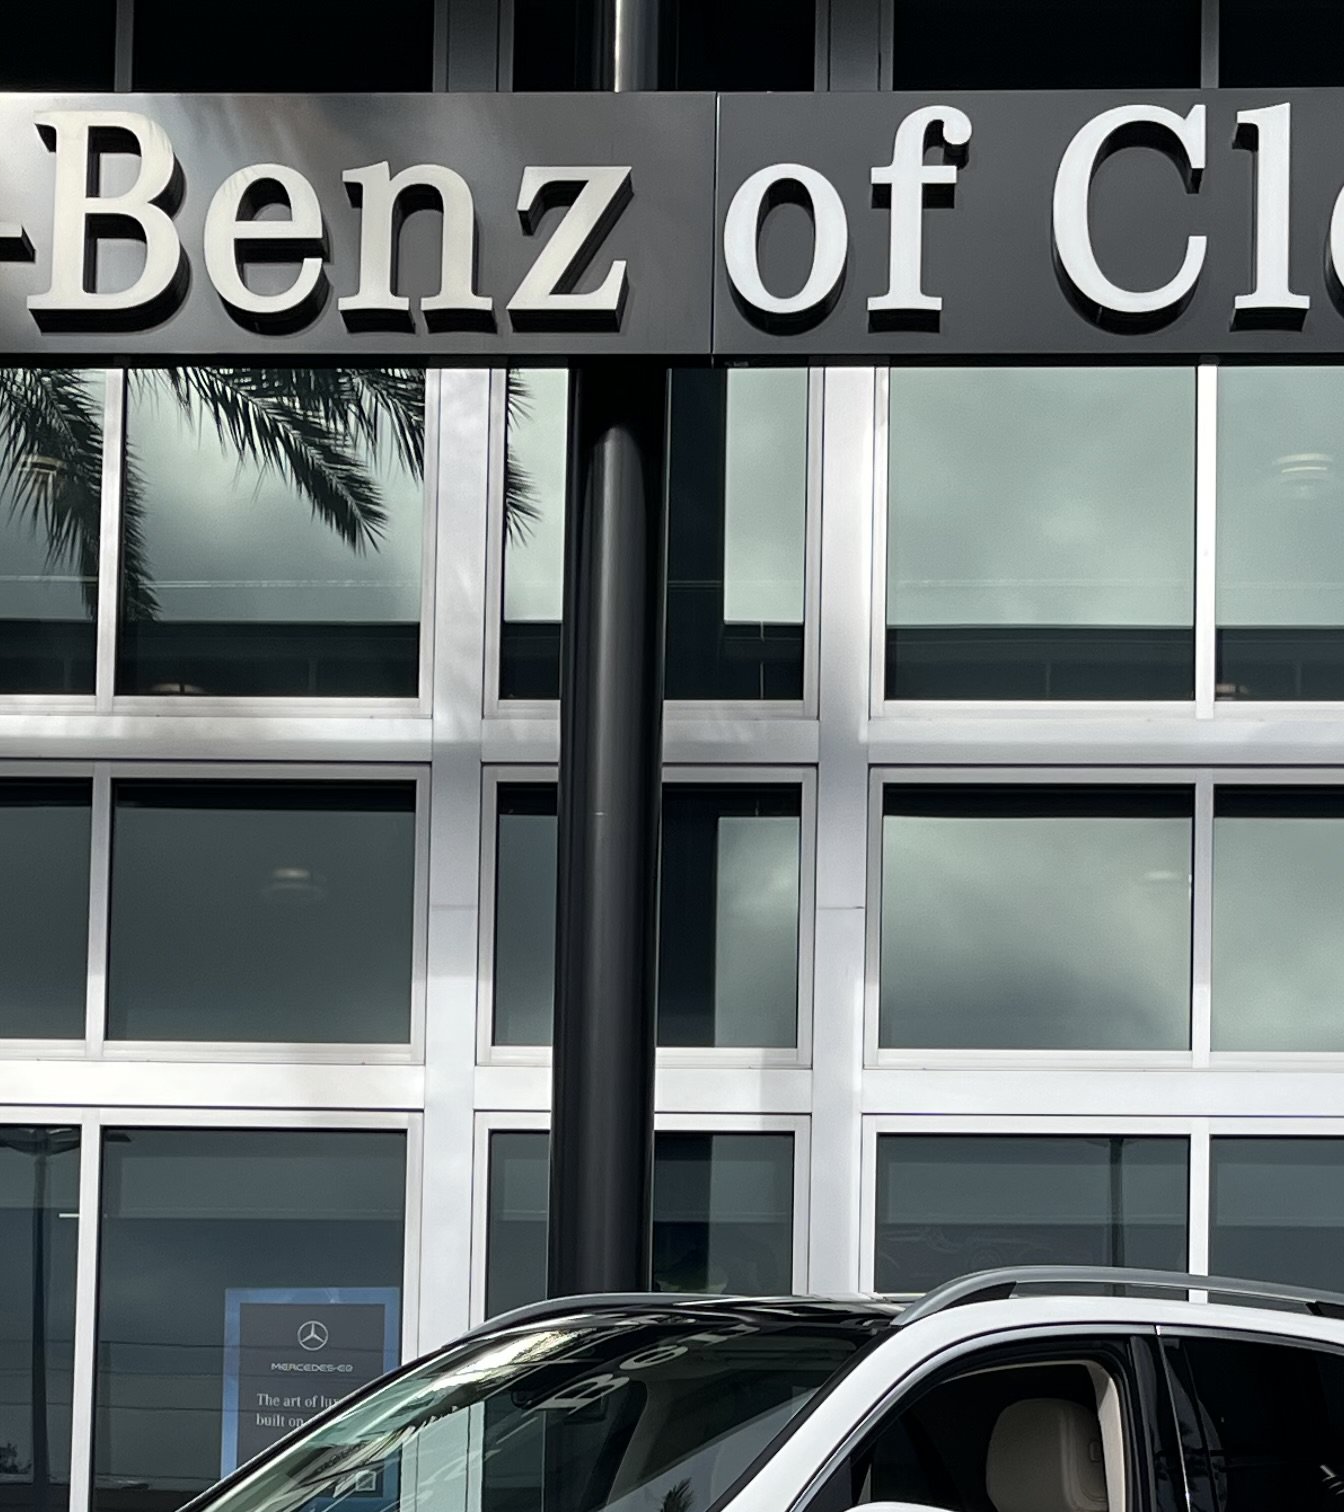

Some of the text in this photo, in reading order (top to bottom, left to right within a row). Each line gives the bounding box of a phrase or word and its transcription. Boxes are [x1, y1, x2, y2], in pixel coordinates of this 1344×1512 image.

[722, 104, 973, 320] of
[256, 1393, 281, 1407] The
[283, 1396, 301, 1408] art
[304, 1395, 318, 1409] of
[256, 1413, 285, 1428] built
